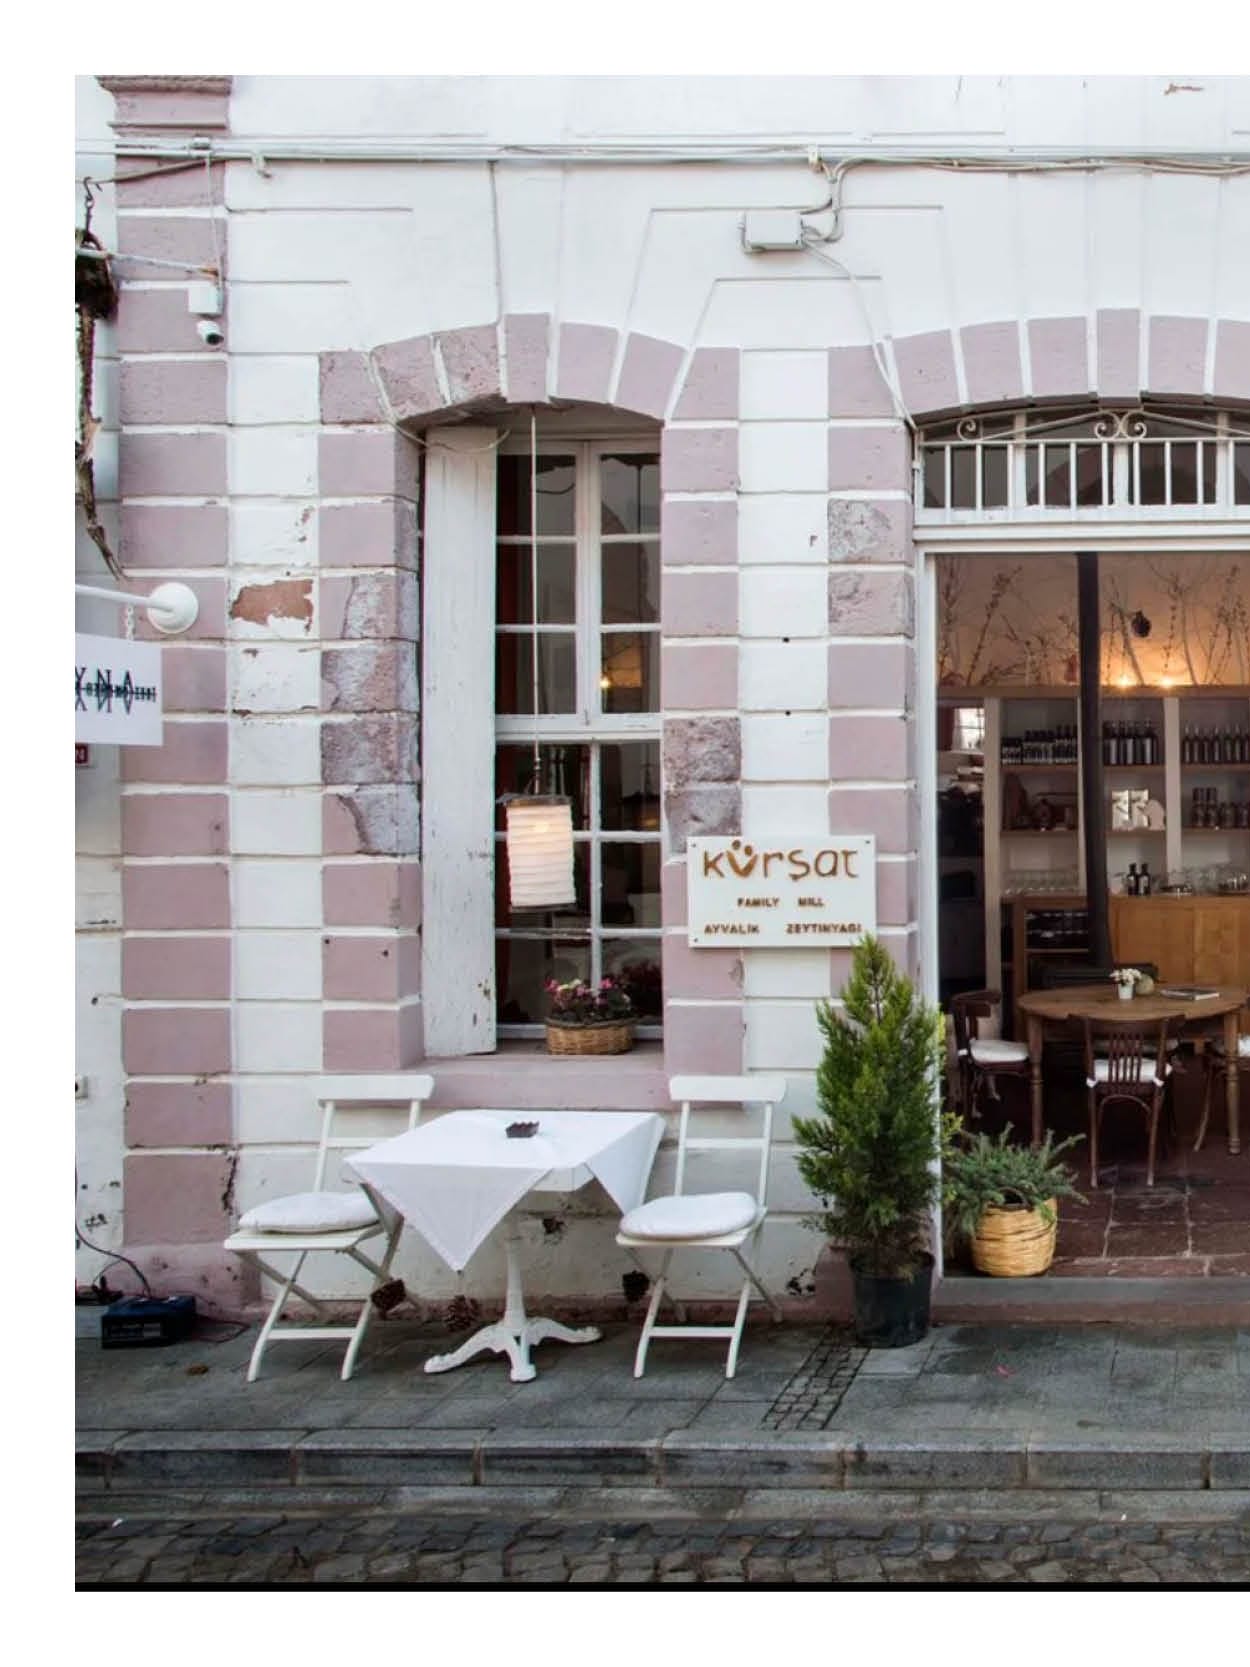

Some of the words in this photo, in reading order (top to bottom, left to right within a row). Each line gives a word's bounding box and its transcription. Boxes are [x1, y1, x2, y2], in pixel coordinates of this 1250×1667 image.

[737, 897, 780, 908] FAMILY
[798, 897, 825, 907] MILL
[704, 923, 760, 935] AYVALIK
